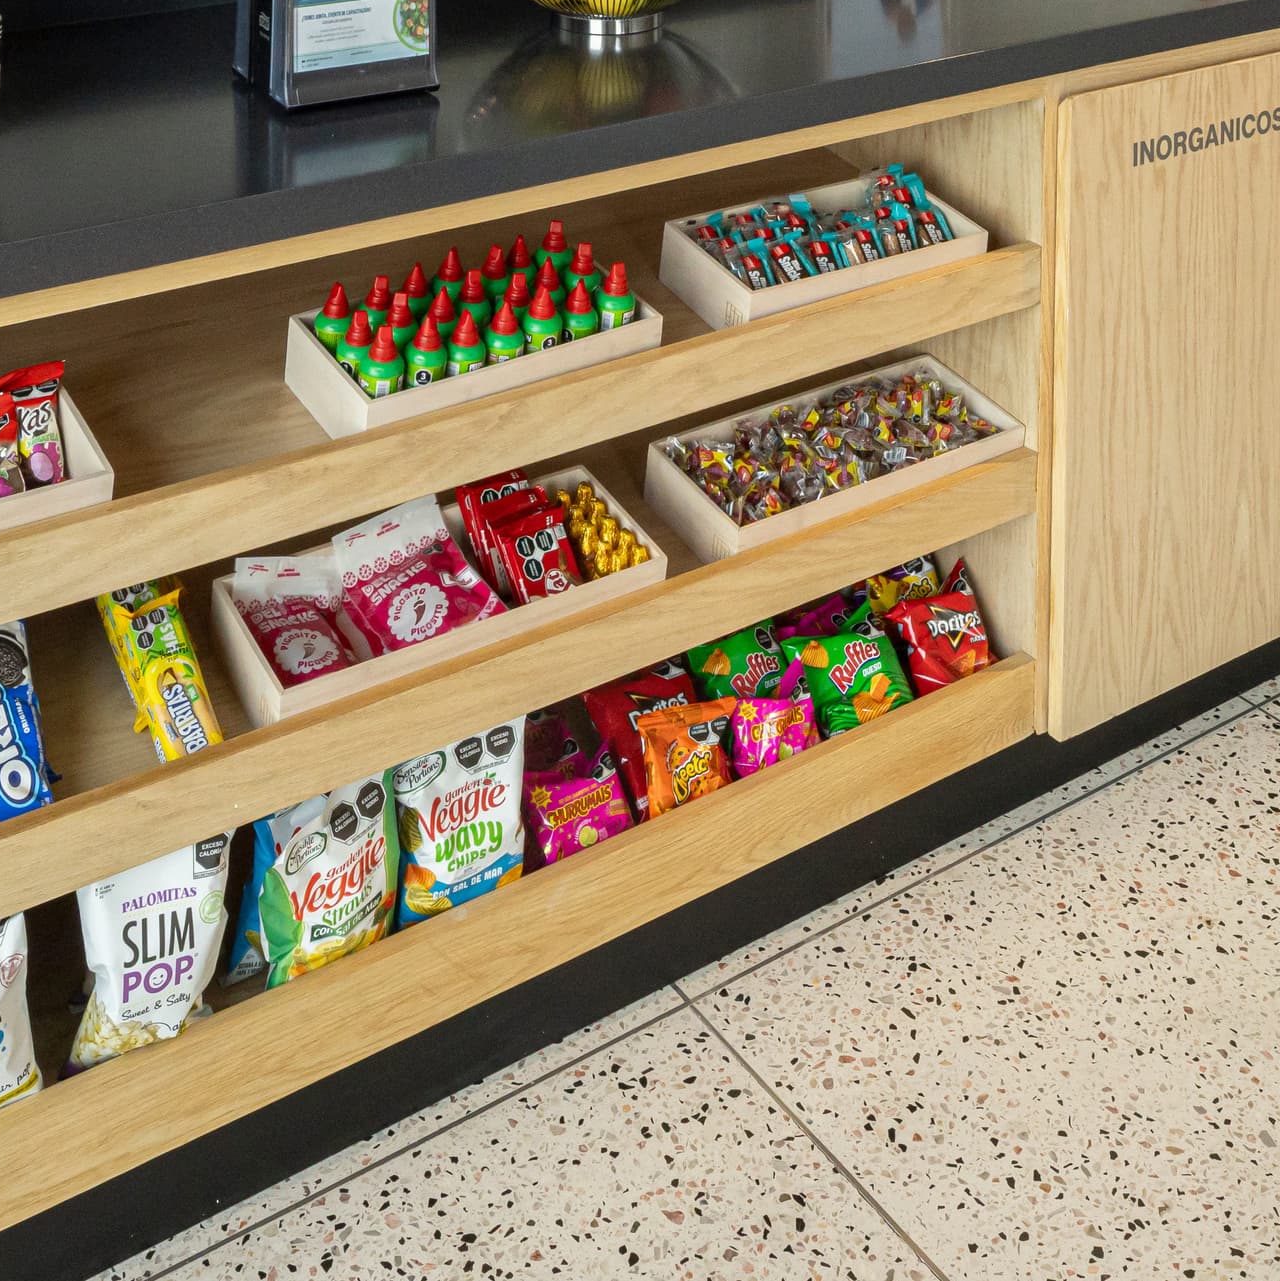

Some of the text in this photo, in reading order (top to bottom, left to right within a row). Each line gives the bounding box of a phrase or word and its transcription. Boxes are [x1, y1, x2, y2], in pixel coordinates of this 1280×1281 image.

[371, 560, 427, 606] SNACKS
[394, 588, 426, 621] PICOSITO
[410, 604, 443, 636] PICOSITO
[259, 610, 320, 633] SNACKS
[927, 610, 981, 638] Doritos
[280, 632, 317, 650] PICOSITO
[730, 653, 779, 697] Ruffles
[829, 641, 881, 695] Ruffles
[163, 683, 208, 755] BARRITAS
[406, 759, 440, 789] Portions
[445, 778, 483, 807] garden
[546, 785, 613, 830] CHURRUMAIS
[417, 784, 506, 842] Veggie
[201, 840, 224, 851] EXCESO
[435, 821, 503, 863] wavy
[326, 847, 364, 880] garden
[447, 849, 487, 873] CHIPS
[290, 837, 386, 921] Veggie
[432, 866, 503, 900] CON SAL DE MAR
[122, 887, 197, 913] PALOMITAS
[122, 907, 195, 968] SLIM
[121, 992, 191, 1021] Sweet & Salty
